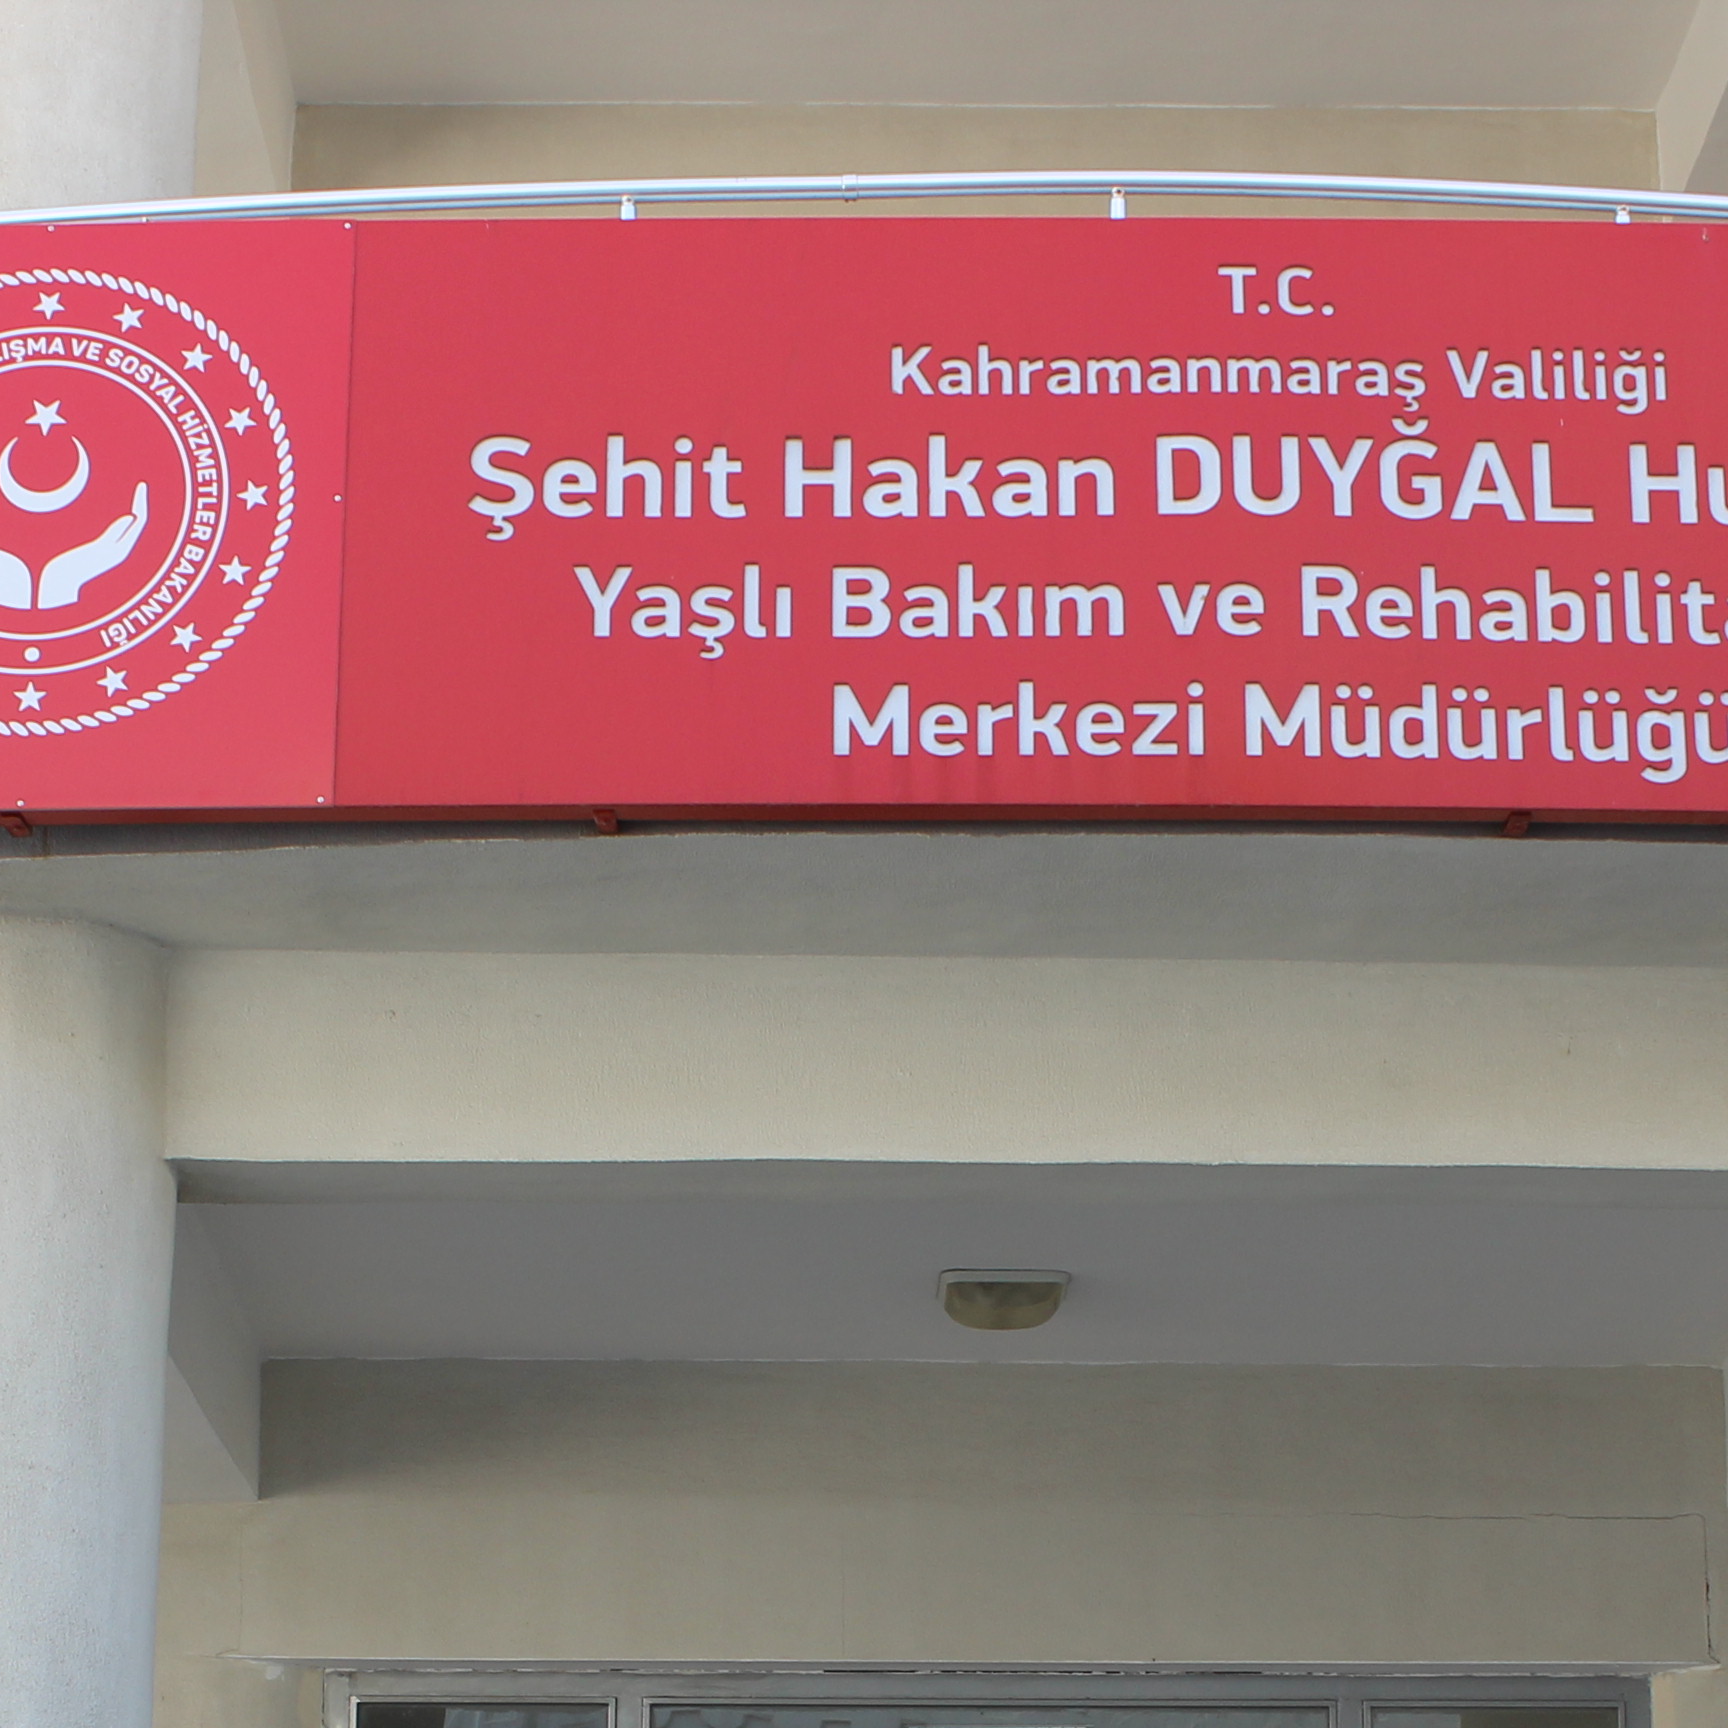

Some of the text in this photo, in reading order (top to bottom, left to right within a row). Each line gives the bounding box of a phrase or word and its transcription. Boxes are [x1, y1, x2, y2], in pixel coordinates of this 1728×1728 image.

[1217, 266, 1335, 316] T.C.
[71, 337, 104, 362] VE
[104, 348, 183, 414] SOSYAL
[891, 345, 1673, 415] Kahramanmaraş Valiliği
[177, 409, 218, 541] HİZMETLER
[467, 436, 747, 542] Şehit
[784, 435, 1115, 520] Hakan
[1155, 418, 1595, 523] DUYĞAL
[100, 540, 205, 648] BAKANLIĞI
[573, 564, 792, 660] Yaşlı
[831, 564, 1125, 640] Bakım
[1157, 584, 1265, 639] ve
[833, 681, 1205, 758] Merkezi
